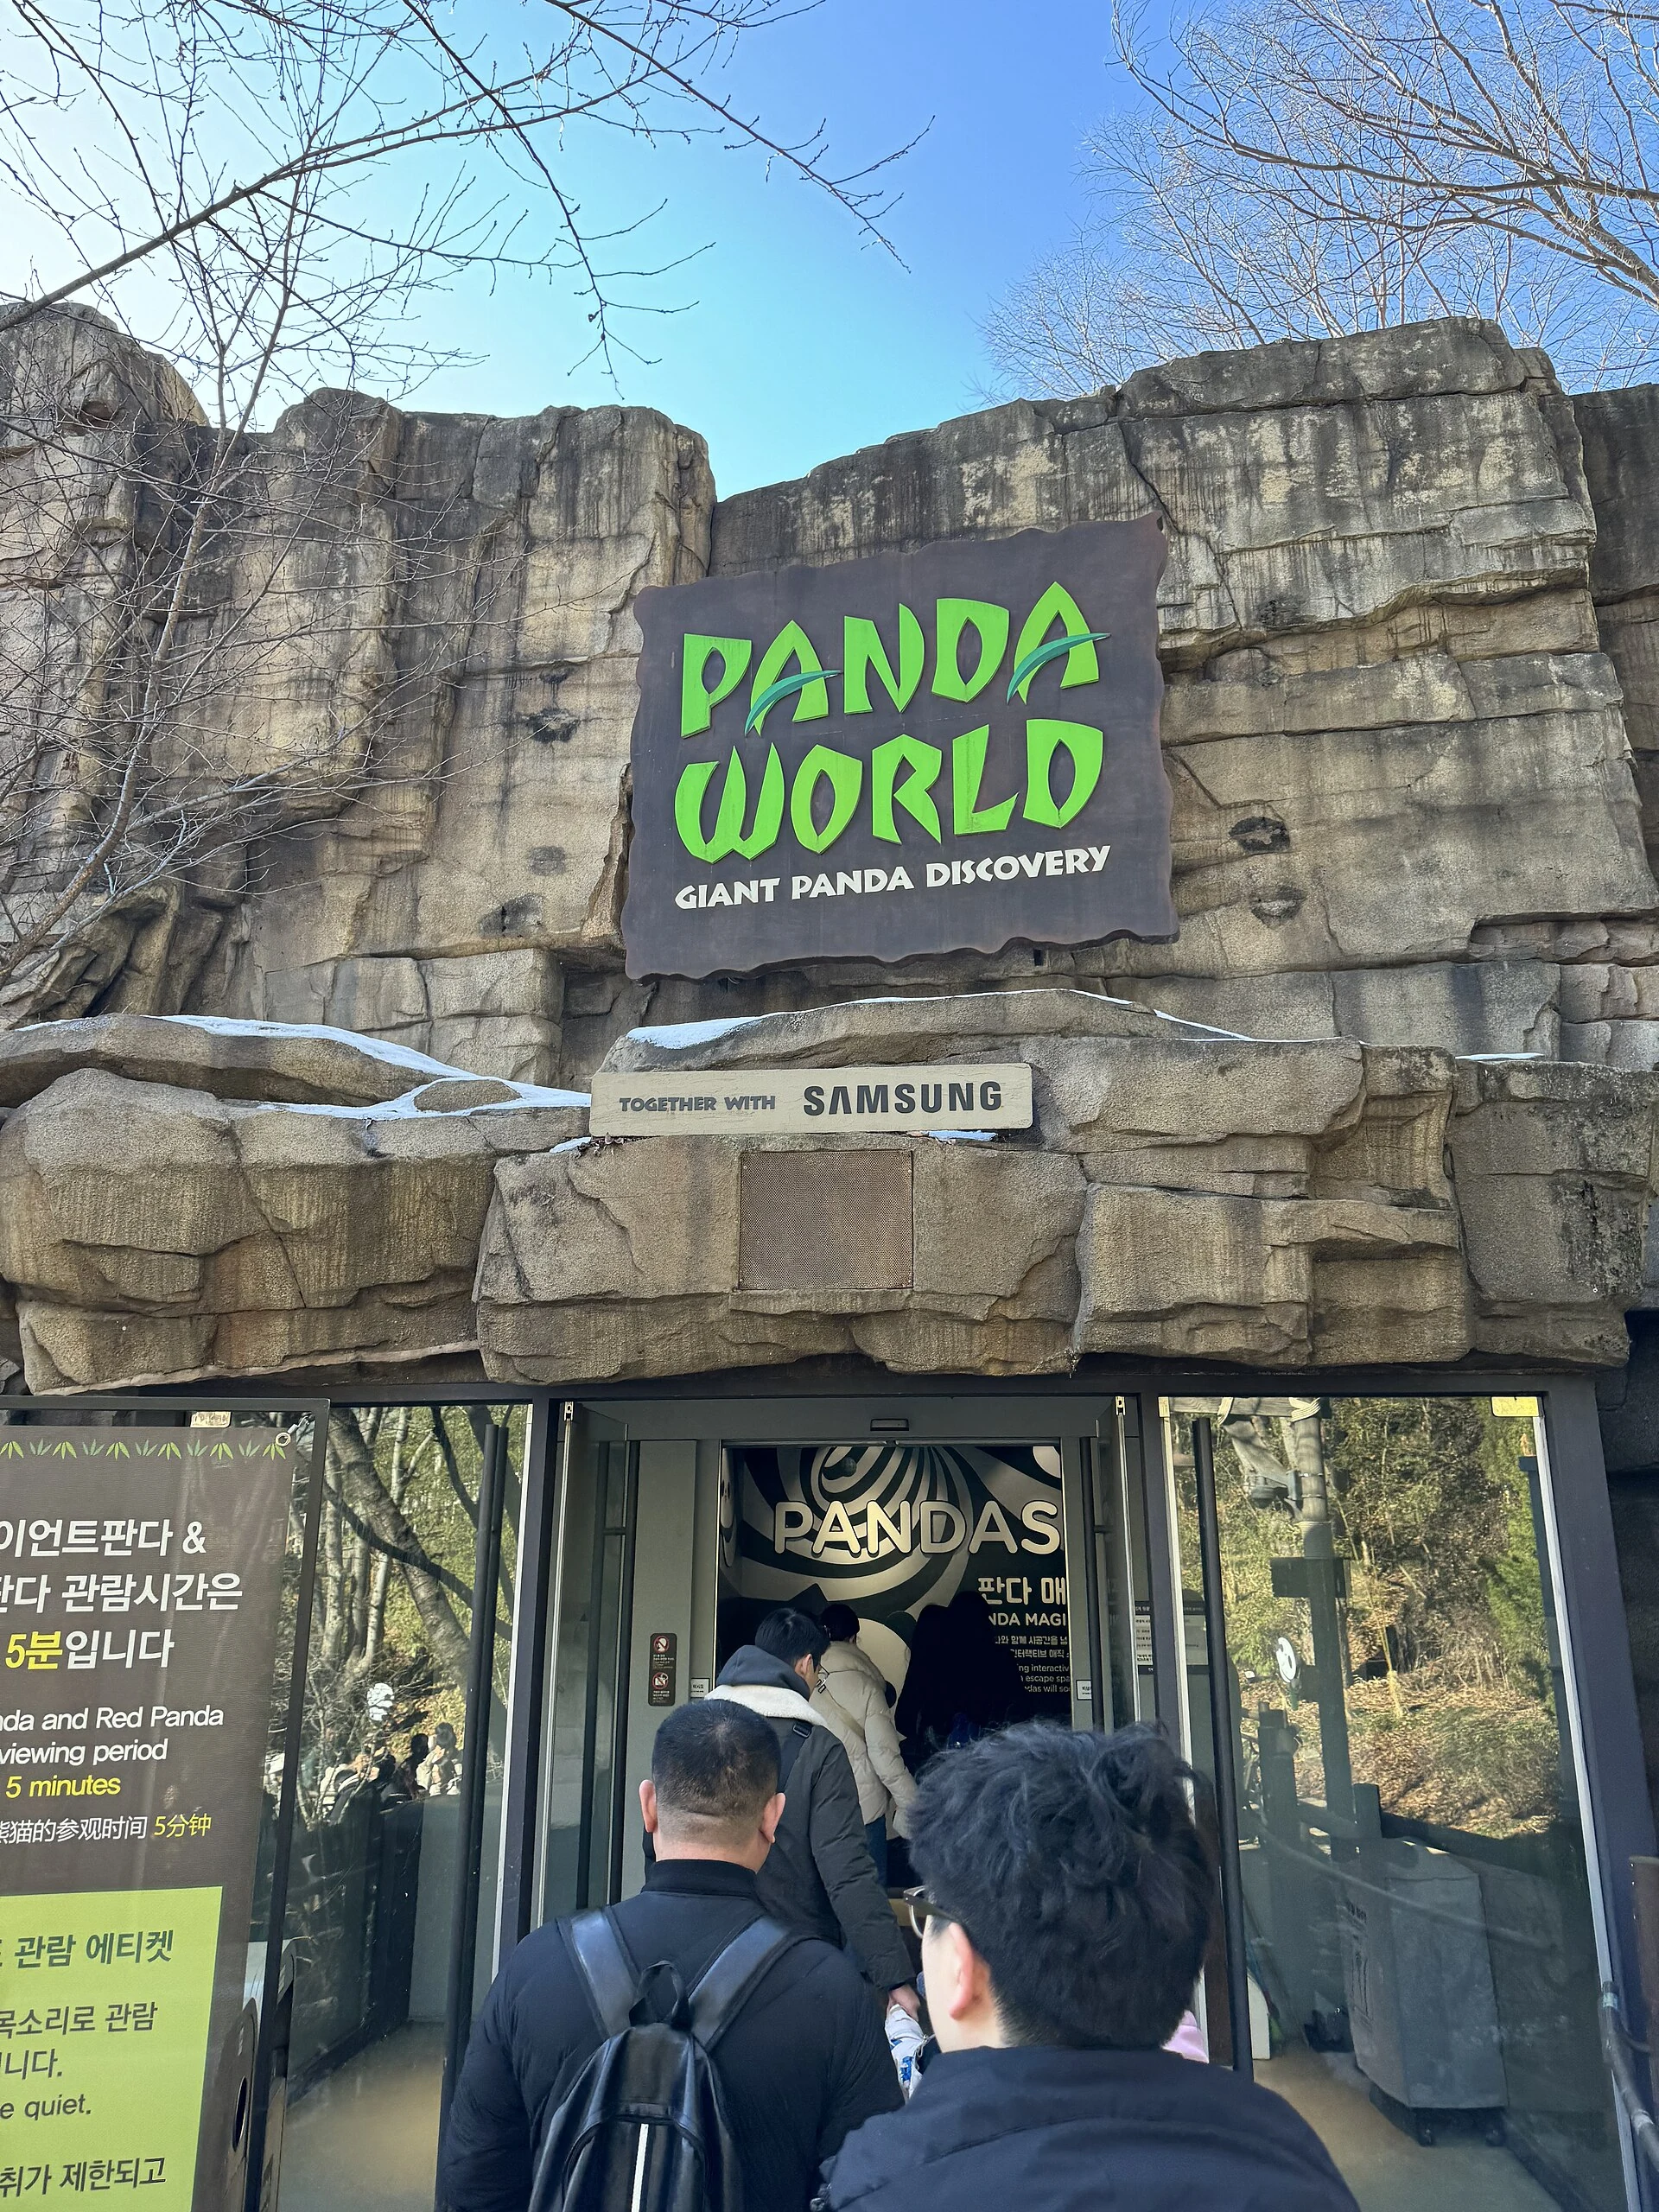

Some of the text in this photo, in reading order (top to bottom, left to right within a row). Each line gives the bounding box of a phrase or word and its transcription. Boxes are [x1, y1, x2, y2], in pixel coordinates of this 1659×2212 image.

[681, 582, 1109, 738] PANDA
[674, 719, 1103, 863] WORLD
[675, 845, 1111, 910] GIANT PANDA DISCOVERY
[620, 1081, 1003, 1116] TOGETHER WITH SAMSUNG
[0, 1518, 207, 1558] 이언트판다 &
[773, 1500, 1061, 1555] PANDAS
[61, 1573, 244, 1613] 관람시간은
[977, 1576, 1067, 1605] 판다 매
[988, 1612, 1067, 1626] NDA MAGI
[5, 1629, 175, 1670] 5분입니다
[1025, 1675, 1055, 1684] escape
[1031, 1663, 1070, 1673] interactiv
[41, 1707, 89, 1731] and
[96, 1706, 143, 1730] Red
[150, 1704, 225, 1728] Panda
[0, 1738, 168, 1766] viewing period
[5, 1774, 122, 1799] 5 minutes
[153, 1813, 213, 1839] 5分钟
[14, 1934, 77, 1969] 관람
[86, 1929, 174, 1965] 에티켓
[105, 2001, 158, 2033] 관람
[0, 2048, 63, 2081] 니다.
[24, 2094, 92, 2121] quiet.
[0, 2157, 167, 2198] 취가 제한되고
